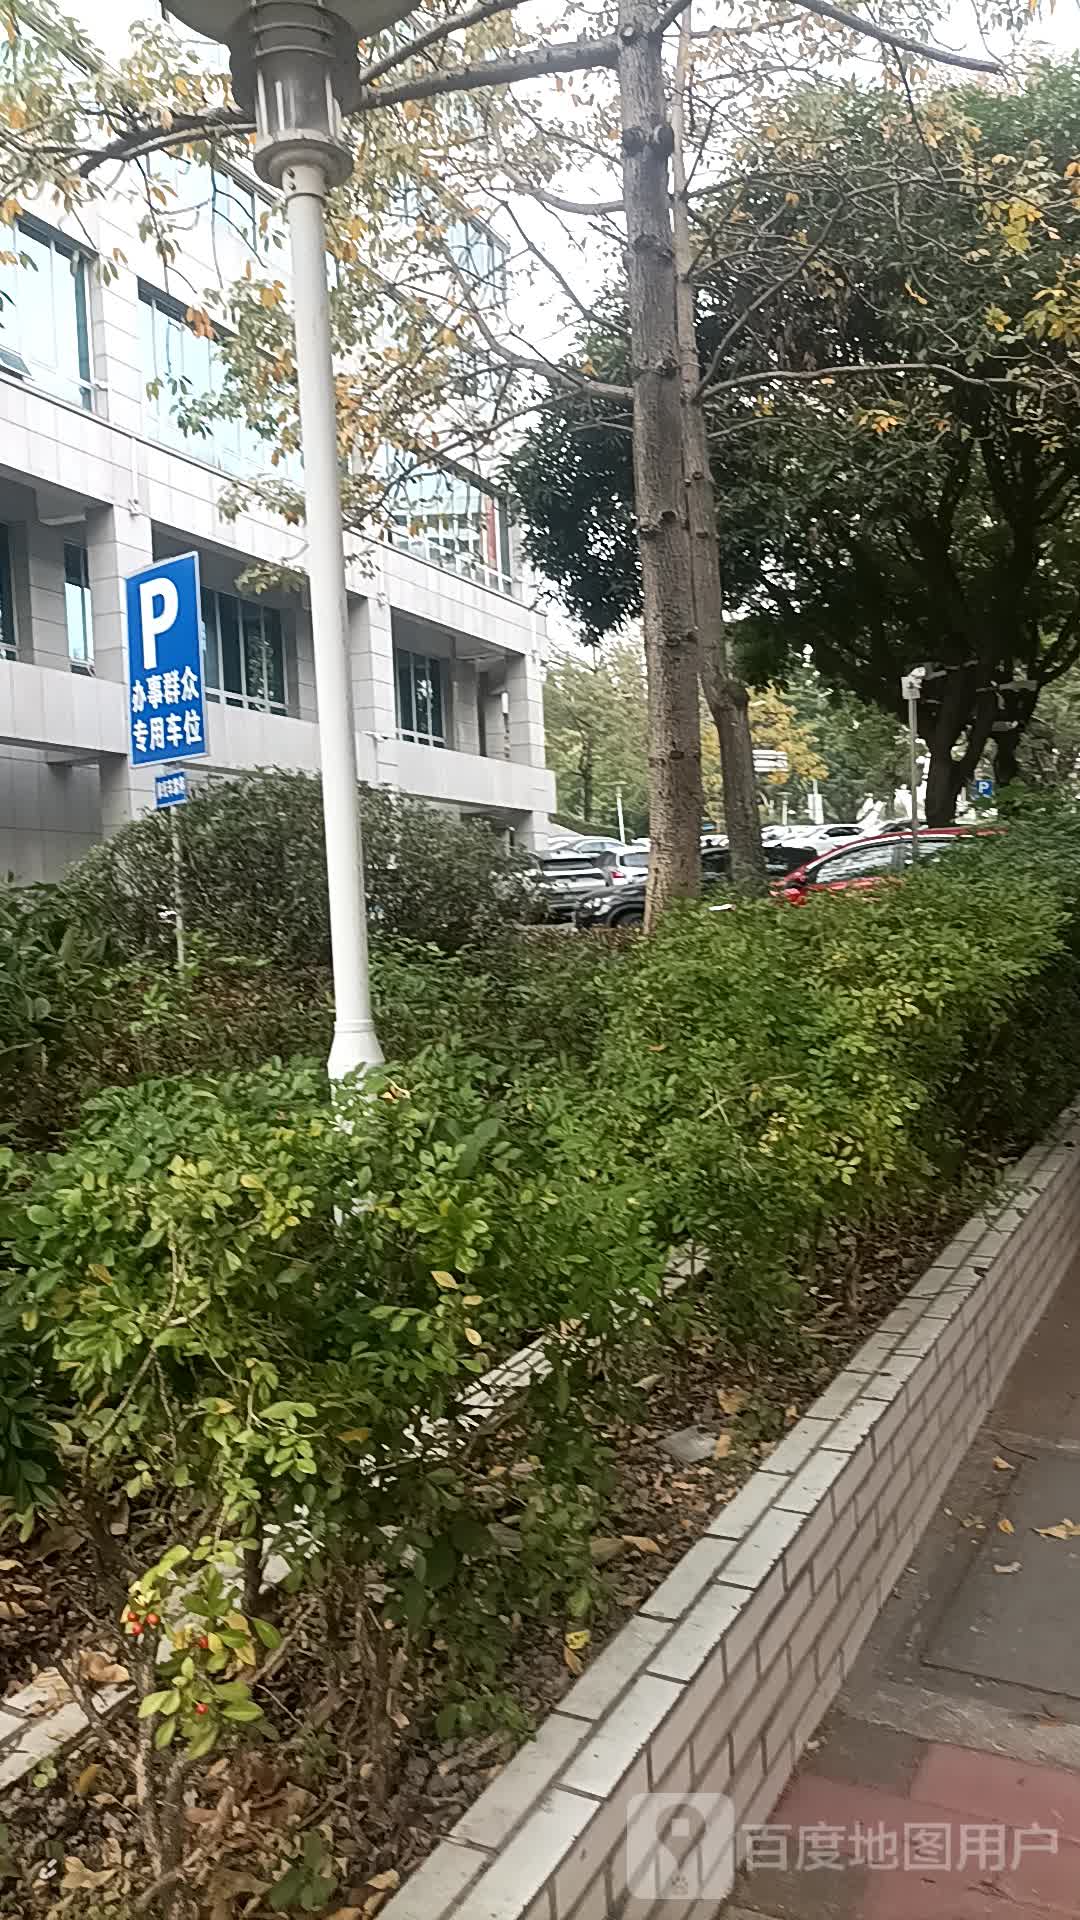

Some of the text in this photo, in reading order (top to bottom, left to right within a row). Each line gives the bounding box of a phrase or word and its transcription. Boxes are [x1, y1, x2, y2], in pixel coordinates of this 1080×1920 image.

[139, 577, 179, 670] P
[132, 666, 200, 713] 办事群众
[133, 709, 202, 753] 专用车位
[978, 781, 990, 794] P
